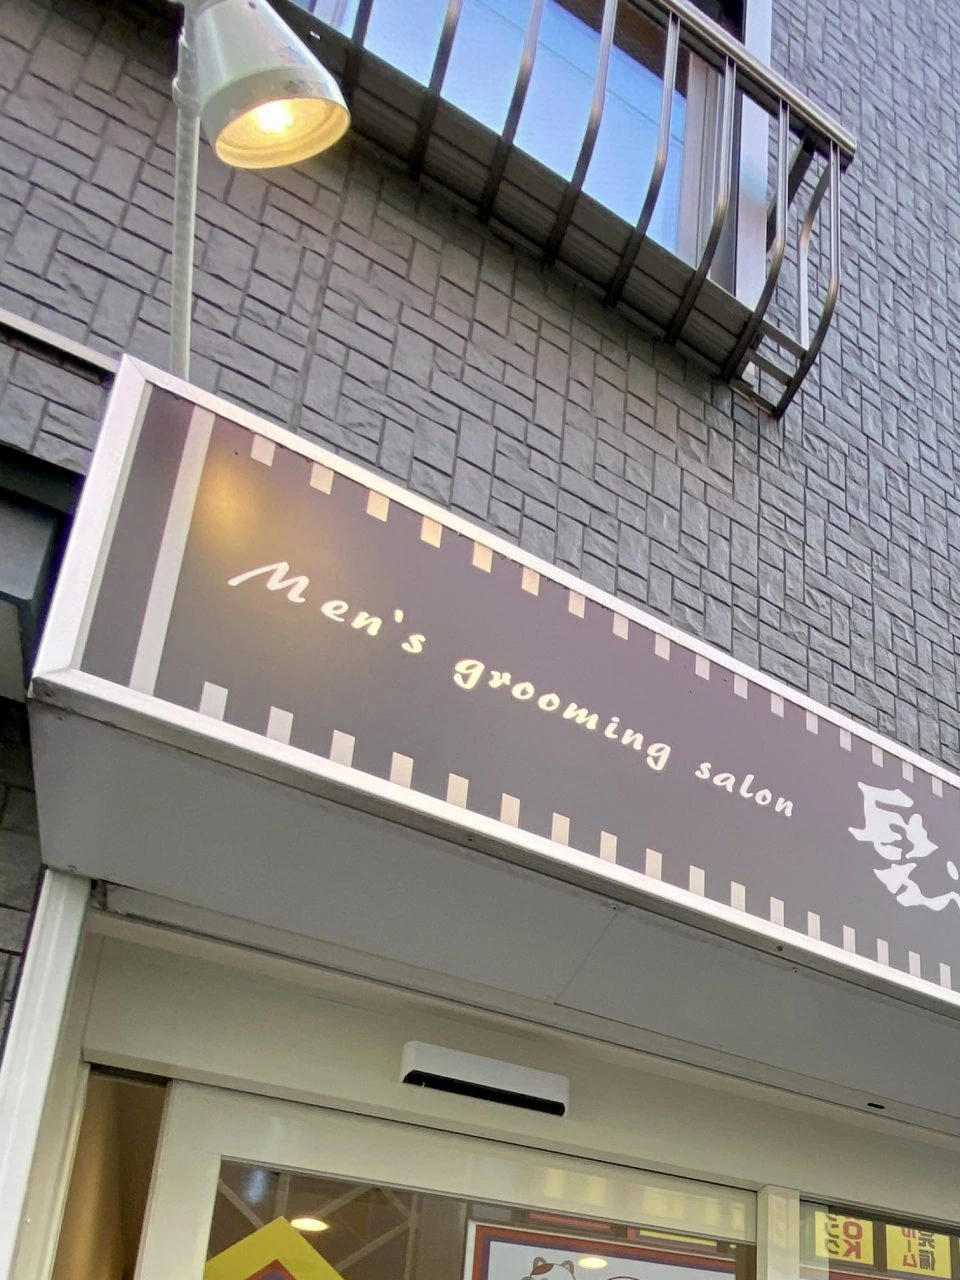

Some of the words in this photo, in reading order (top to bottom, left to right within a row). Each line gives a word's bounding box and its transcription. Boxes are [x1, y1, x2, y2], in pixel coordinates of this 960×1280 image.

[227, 560, 428, 656] Men's
[452, 656, 673, 771] grooming
[694, 758, 795, 819] salon
